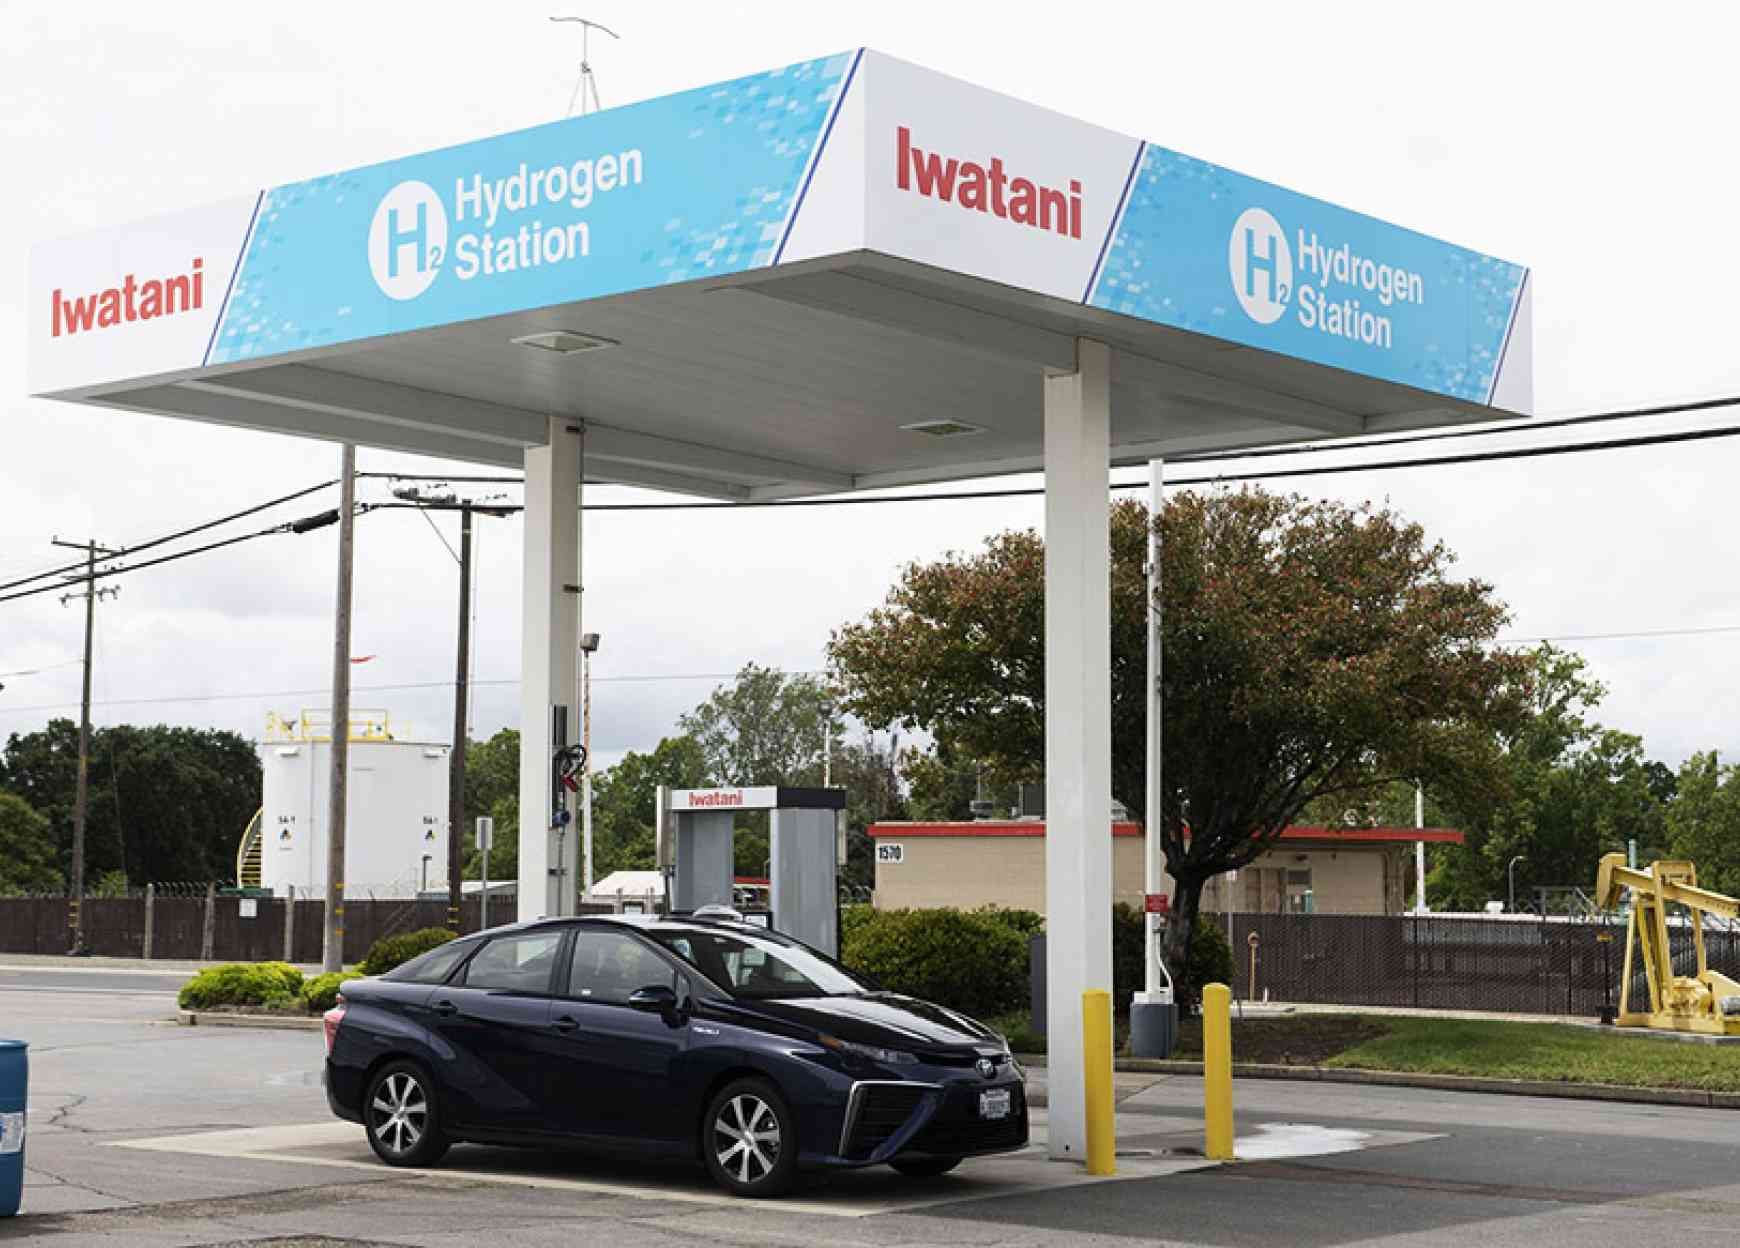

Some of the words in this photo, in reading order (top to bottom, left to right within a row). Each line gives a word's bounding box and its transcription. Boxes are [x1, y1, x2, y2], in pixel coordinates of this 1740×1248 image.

[455, 148, 643, 228] Hydrogen
[896, 126, 1082, 240] Iwatani
[455, 220, 590, 281] Station
[1298, 228, 1424, 305] Hydrogen
[52, 257, 203, 337] Iwatani
[1298, 284, 1392, 349] Station
[688, 790, 743, 806] Iwatani
